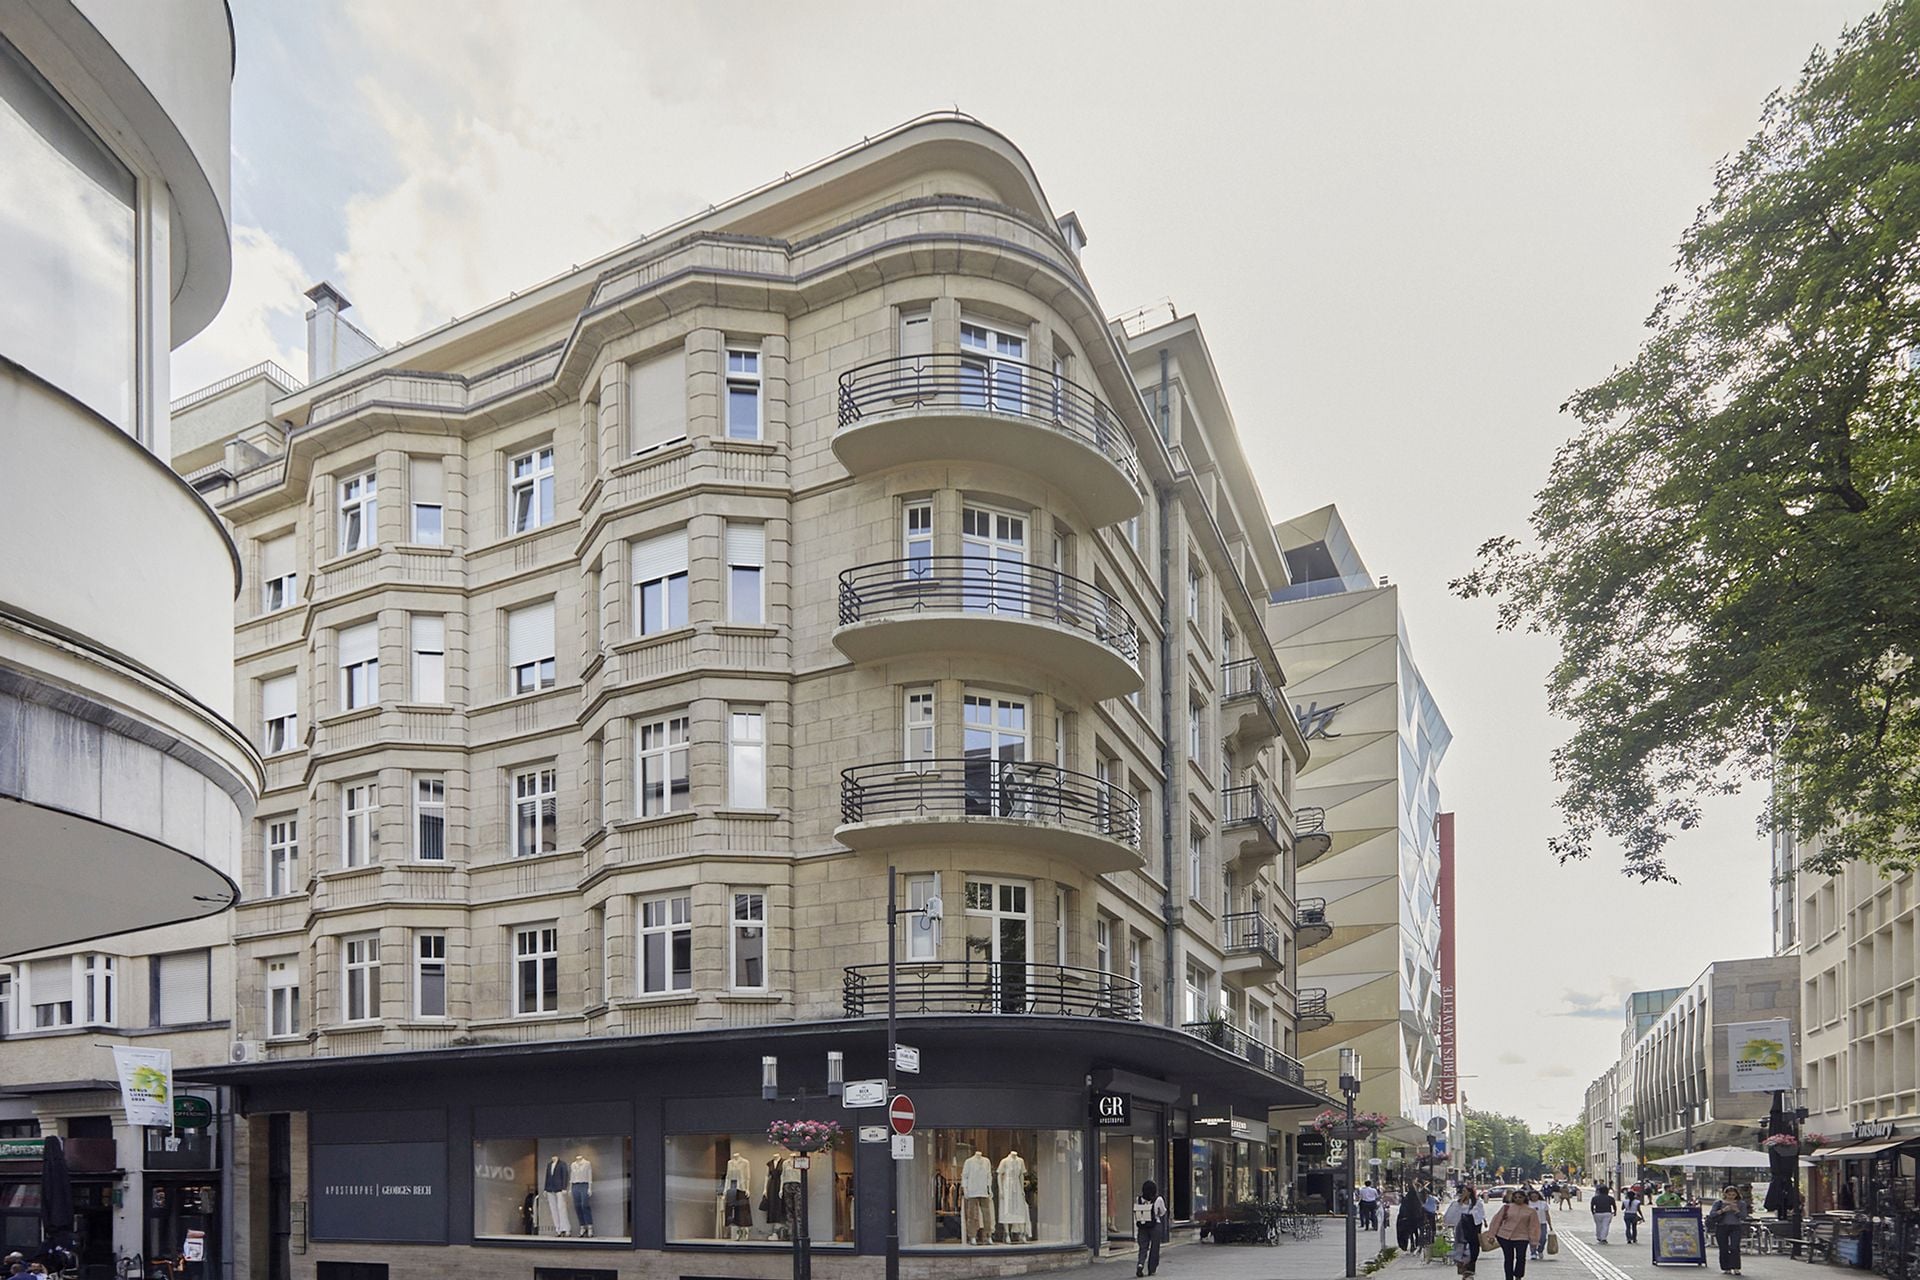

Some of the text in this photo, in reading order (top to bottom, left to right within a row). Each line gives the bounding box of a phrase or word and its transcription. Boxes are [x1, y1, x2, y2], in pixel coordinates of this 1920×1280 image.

[1442, 985, 1455, 1101] GALERIES LAFAYETTE
[1099, 1096, 1124, 1116] GR
[1231, 1120, 1247, 1129] EEKEND
[1851, 1119, 1893, 1140] Finsbury
[1326, 1138, 1342, 1167] fna
[325, 1186, 432, 1195] APOSTROPHE GEORGES RECH
